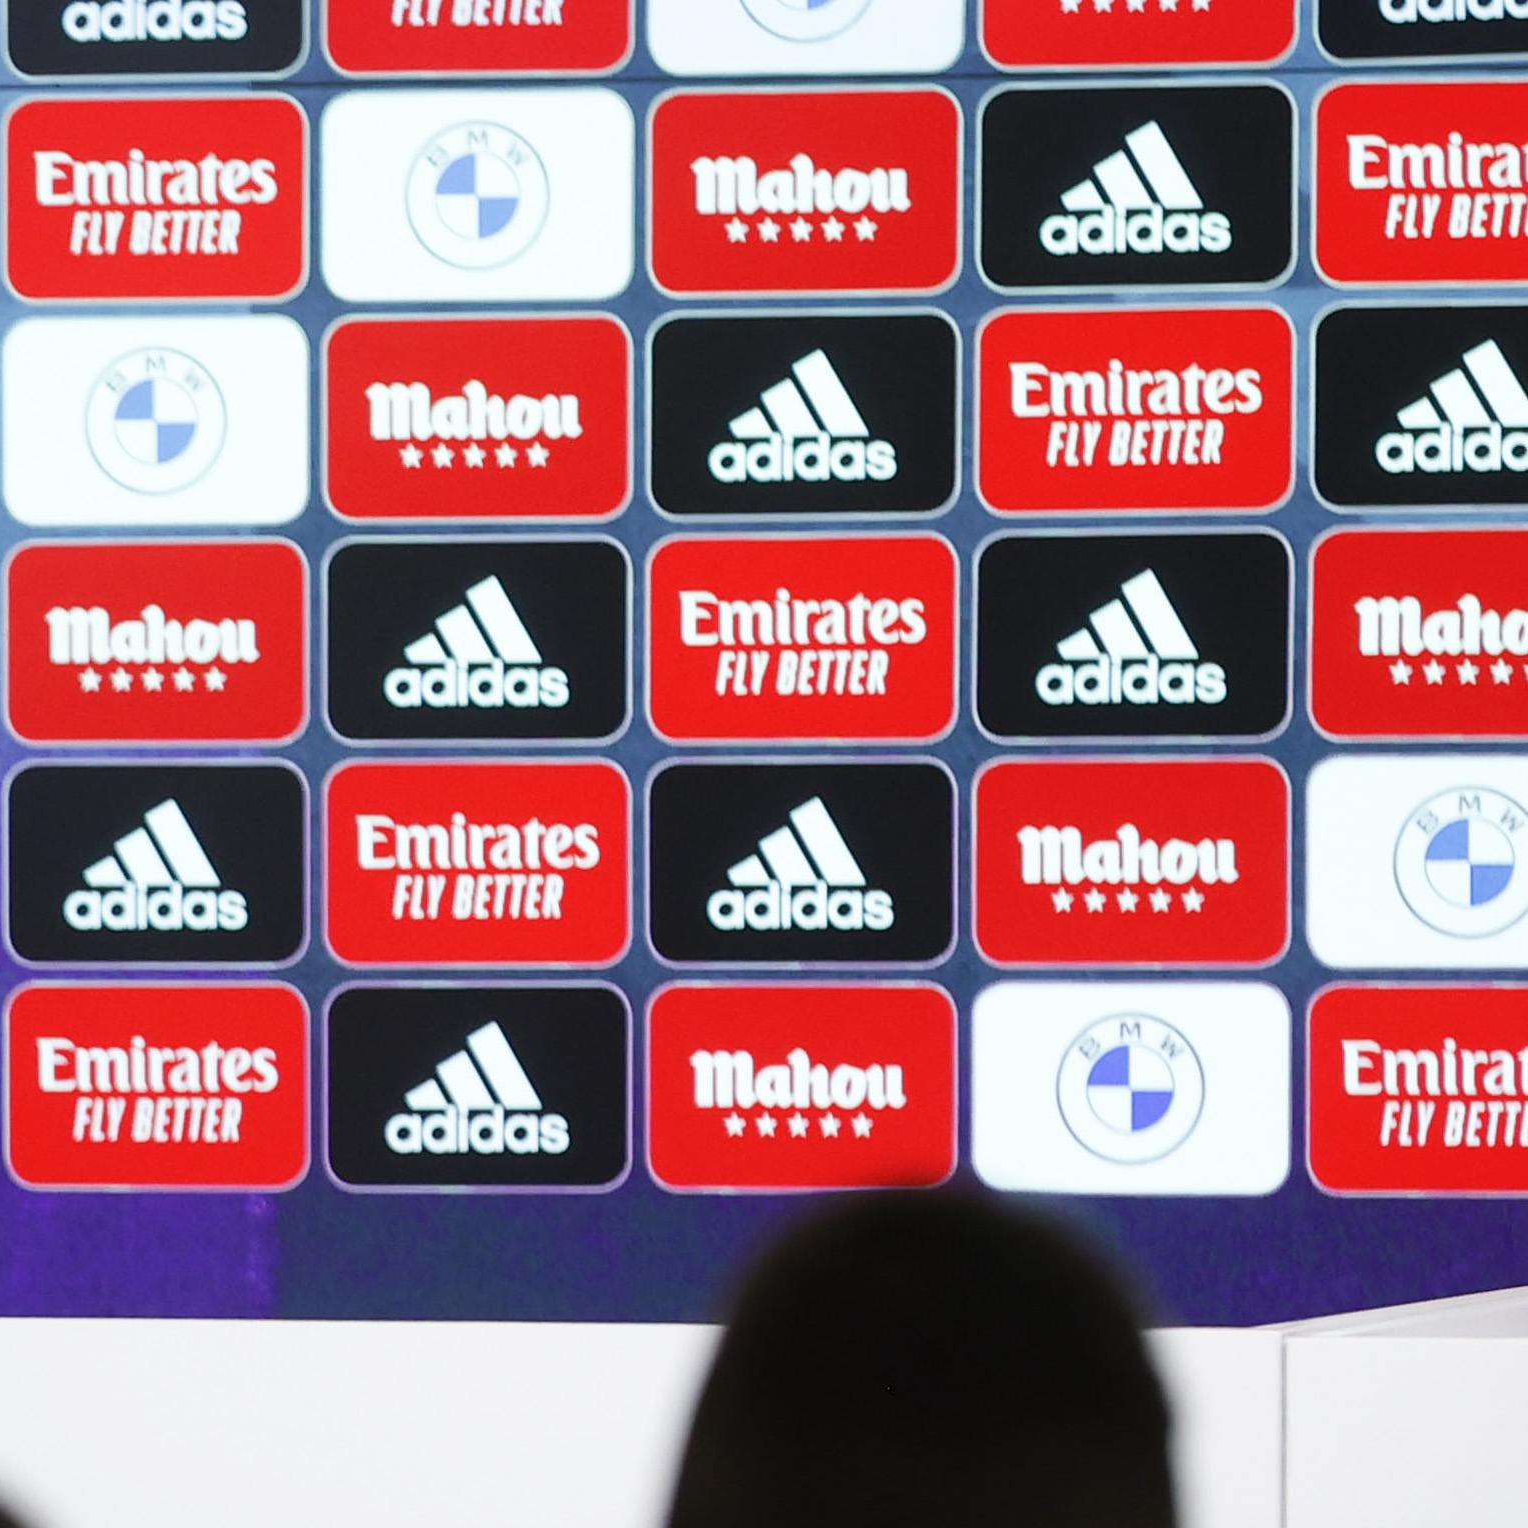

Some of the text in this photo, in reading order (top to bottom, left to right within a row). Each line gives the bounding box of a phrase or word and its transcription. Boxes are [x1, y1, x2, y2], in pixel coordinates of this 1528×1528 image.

[62, 0, 247, 42] adidas
[34, 149, 277, 206] Emirates
[691, 154, 911, 214] Mahou
[1347, 132, 1528, 189] Emira
[70, 210, 241, 255] FLY BETTER
[1040, 203, 1231, 255] adidas
[1385, 193, 1528, 238] FLY BETT
[366, 380, 582, 441] Mahou
[1010, 359, 1262, 417] Emirates
[708, 431, 897, 482] adidas
[1047, 419, 1224, 466] FLY BETTER
[1376, 422, 1528, 473] adida
[45, 605, 260, 664] Mahou
[679, 588, 926, 646] Emirates
[1354, 594, 1528, 656] Maho
[384, 657, 569, 707] adidas
[716, 650, 889, 695] FLY BETTER
[1036, 653, 1226, 704] adidas
[356, 813, 600, 869] Emirates
[1017, 824, 1239, 884] Mahou
[64, 880, 247, 930] adidas
[393, 874, 564, 919] FLY BETTER
[707, 879, 894, 930] adidas
[37, 1036, 278, 1092] Emirates
[690, 1048, 906, 1109] Mahou
[1342, 1038, 1528, 1095] Emira
[74, 1097, 242, 1142] FLY BETTER
[385, 1103, 569, 1153] adidas
[1381, 1101, 1528, 1146] FLY BETT
